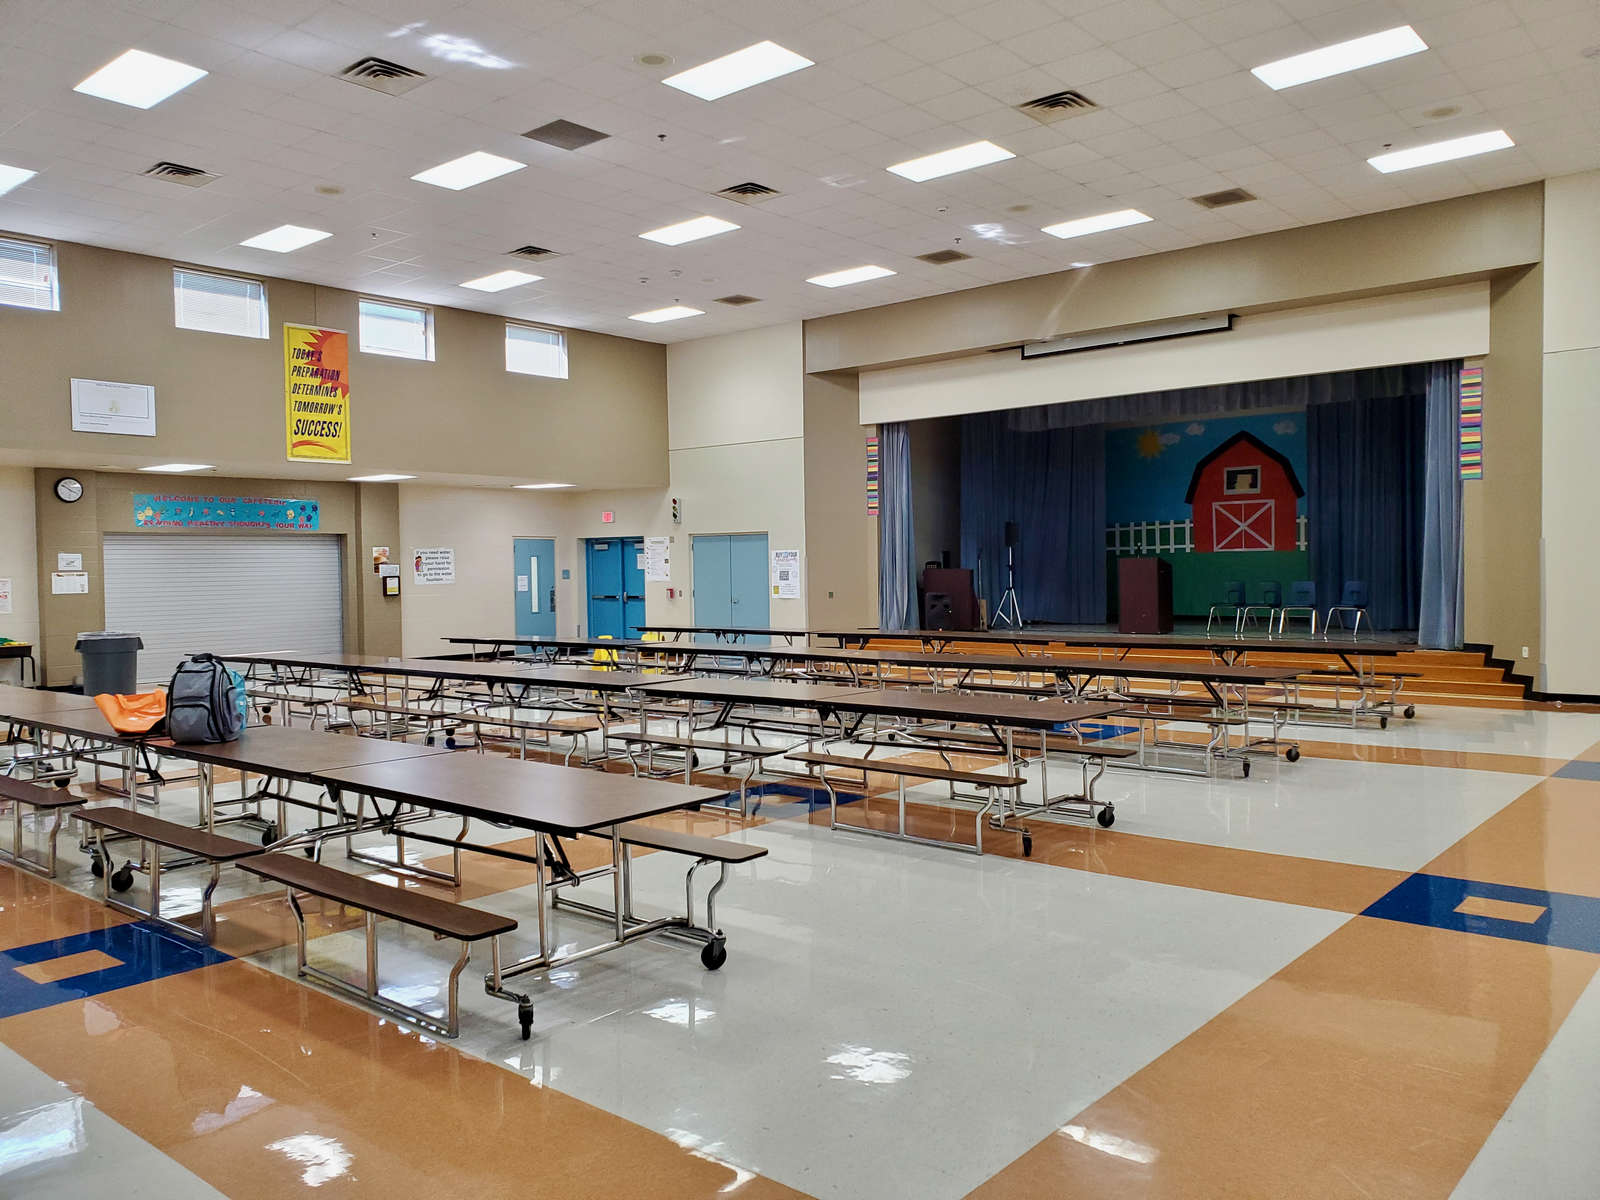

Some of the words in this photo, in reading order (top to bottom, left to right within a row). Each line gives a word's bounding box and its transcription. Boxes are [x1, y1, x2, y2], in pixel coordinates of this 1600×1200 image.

[291, 347, 322, 362] TODAY'S
[291, 365, 341, 382] PREPARATION
[291, 383, 338, 398] DETERMINES
[293, 400, 343, 415] TOMORROW'S
[293, 418, 343, 438] SUCCESS!
[153, 495, 200, 503] WELCOME
[203, 495, 214, 503] TO
